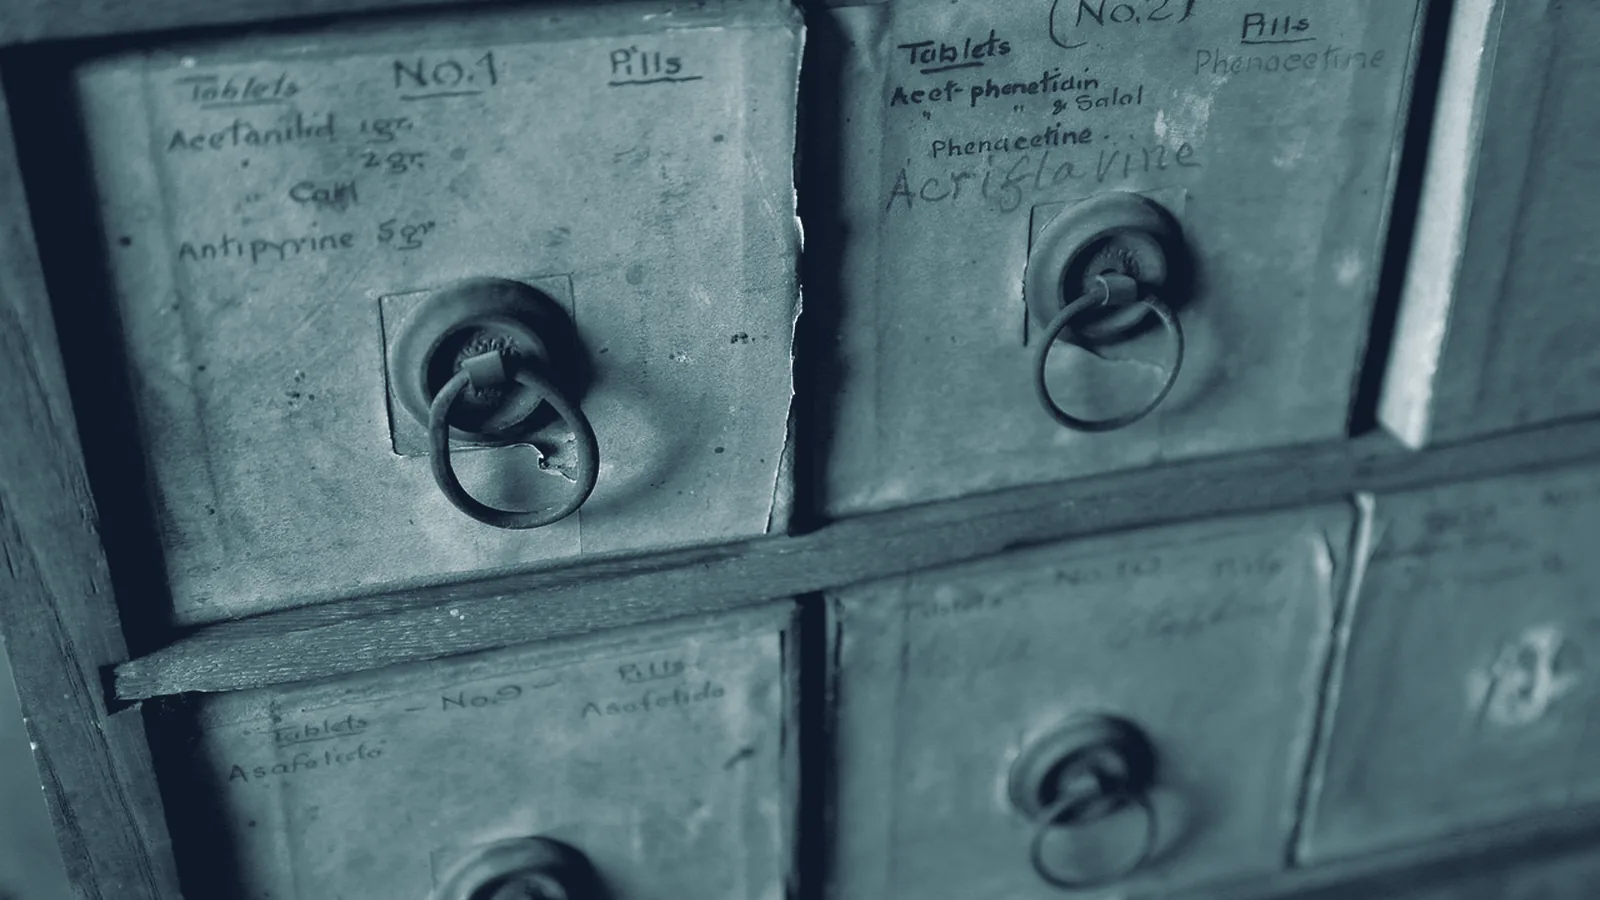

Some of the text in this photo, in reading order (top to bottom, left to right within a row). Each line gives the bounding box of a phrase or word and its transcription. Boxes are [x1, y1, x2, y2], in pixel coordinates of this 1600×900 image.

[1241, 12, 1311, 40] Pills
[610, 45, 682, 76] Pills
[898, 29, 1012, 65] Tablets
[175, 70, 299, 101] Tablets
[931, 121, 1093, 158] Phenacetine
[178, 220, 355, 264] Antipyrine
[259, 713, 370, 743] Tablets
